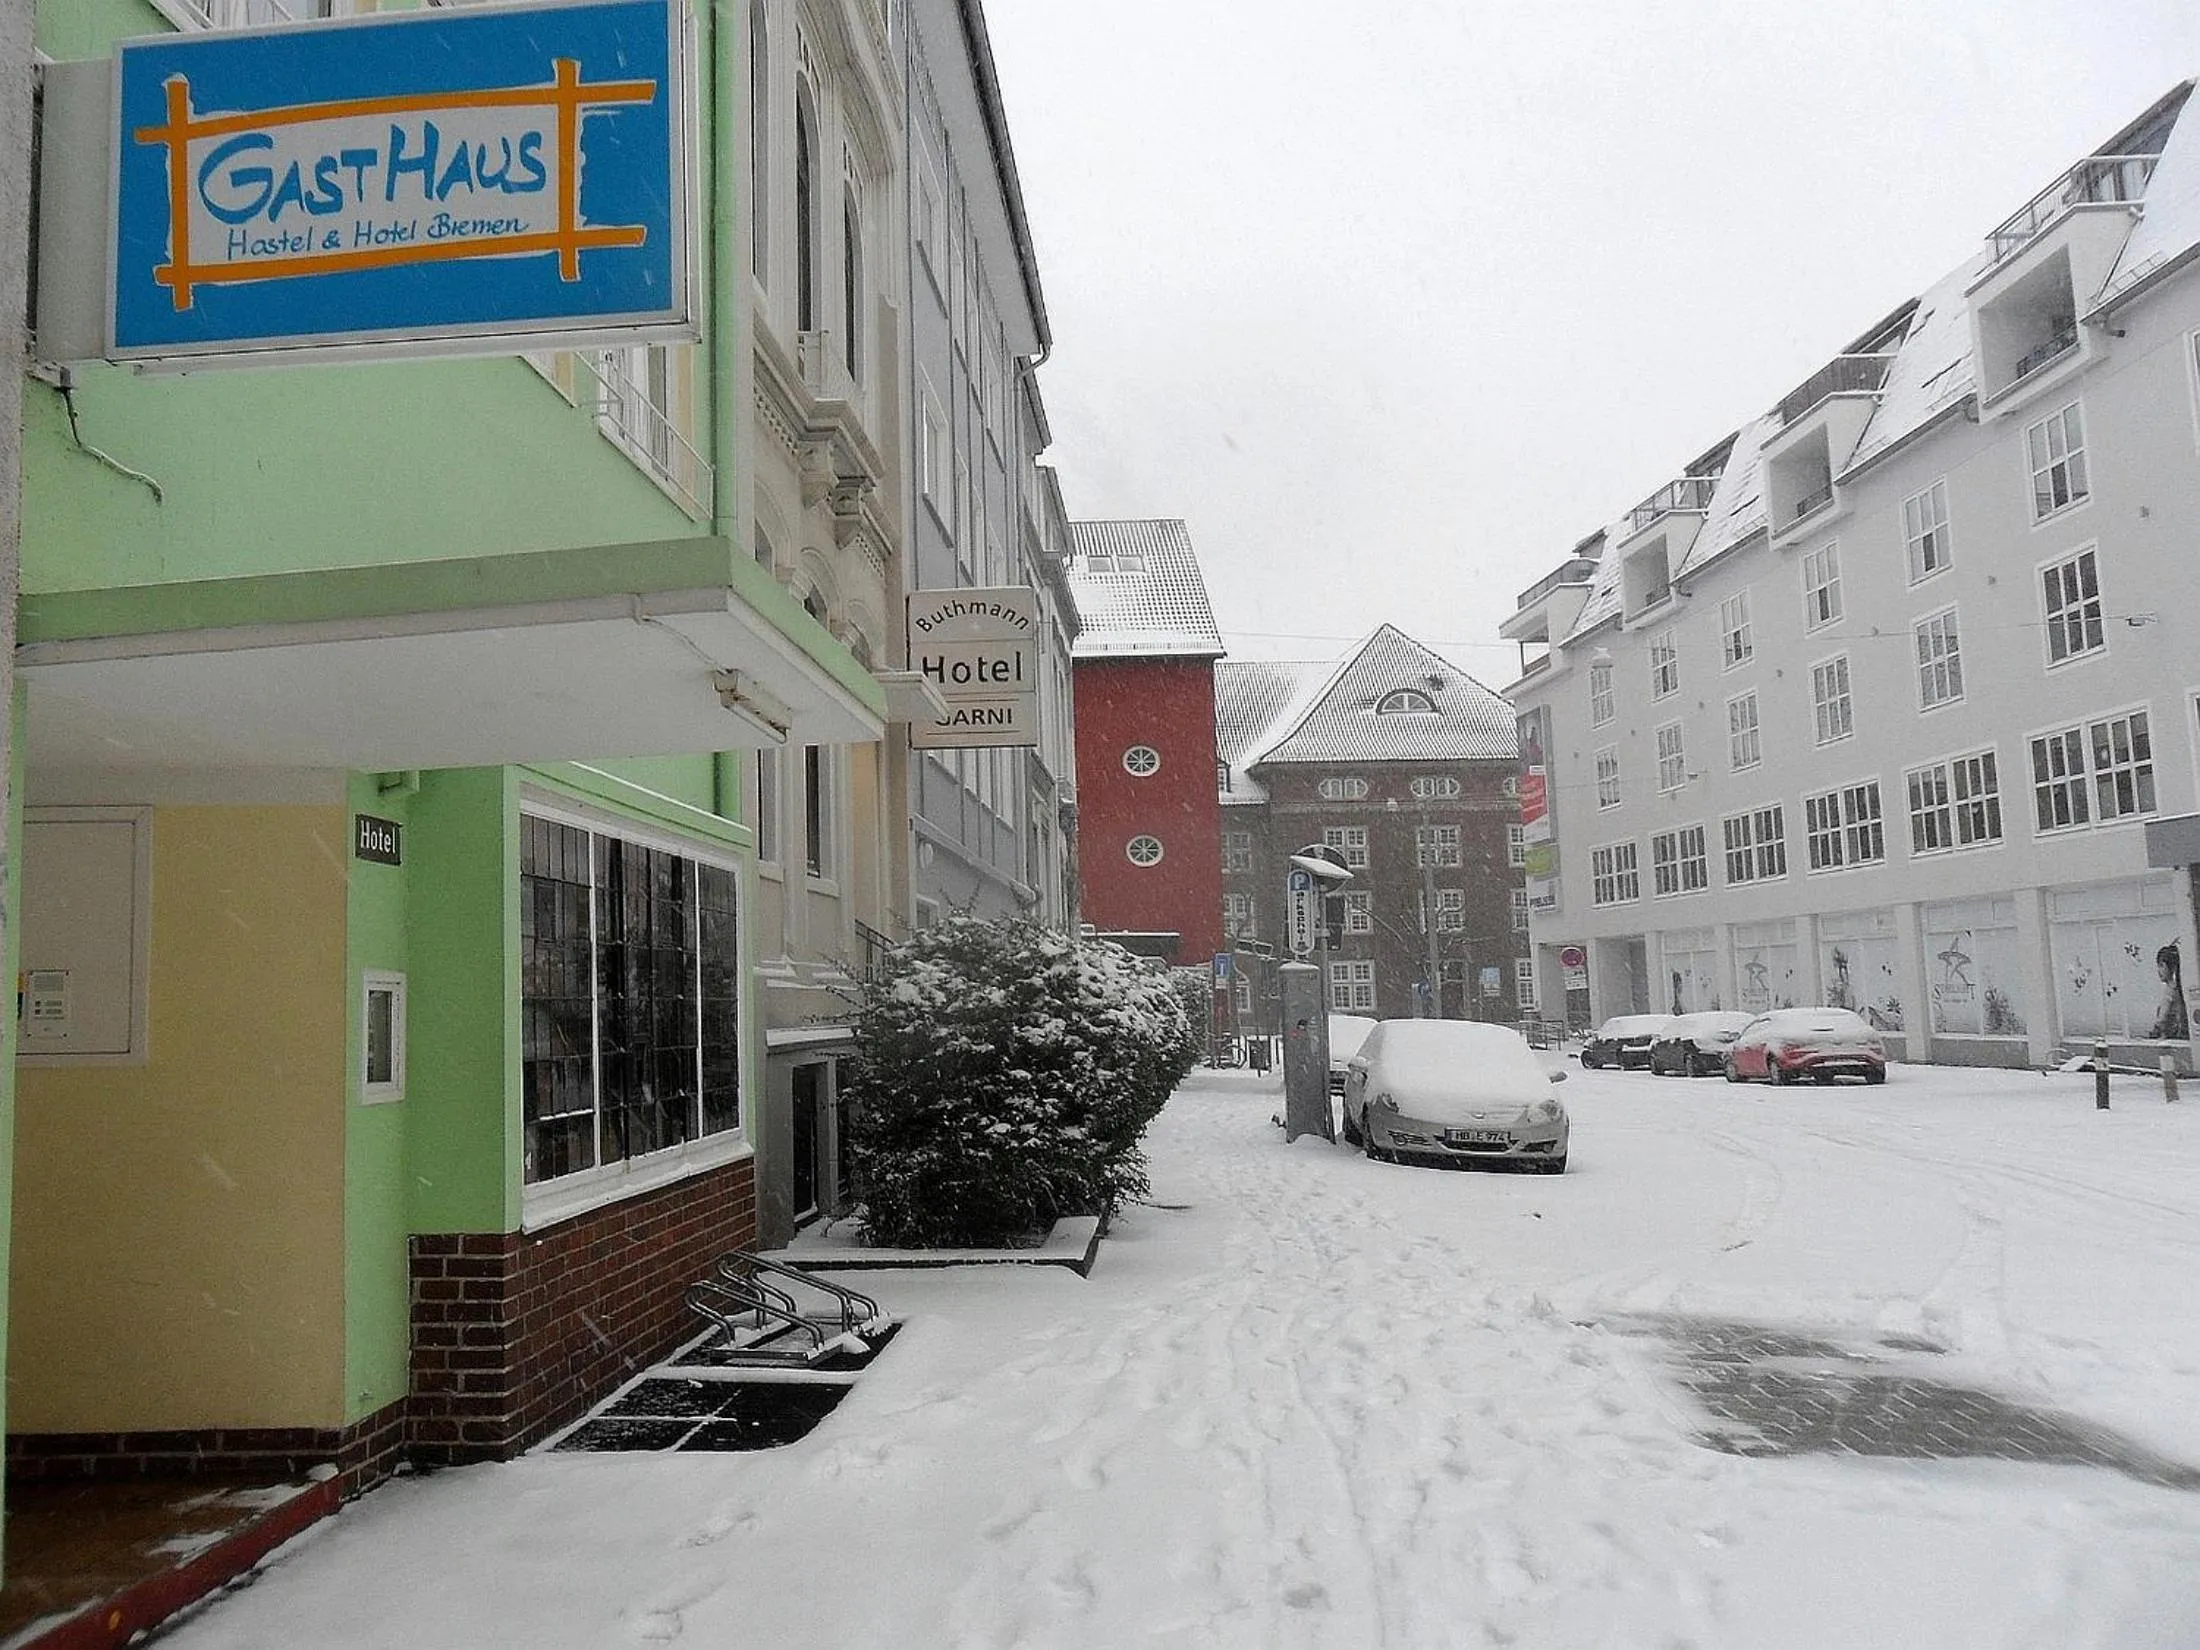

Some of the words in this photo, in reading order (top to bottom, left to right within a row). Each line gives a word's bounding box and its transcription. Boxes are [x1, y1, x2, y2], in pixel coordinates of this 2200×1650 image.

[228, 226, 312, 260] Hostel
[322, 229, 341, 249] &
[354, 219, 417, 247] Hotel
[427, 213, 529, 239] Bremen
[916, 600, 1029, 632] Buthmann
[922, 651, 1022, 684] Hotel
[360, 820, 396, 854] Hotel
